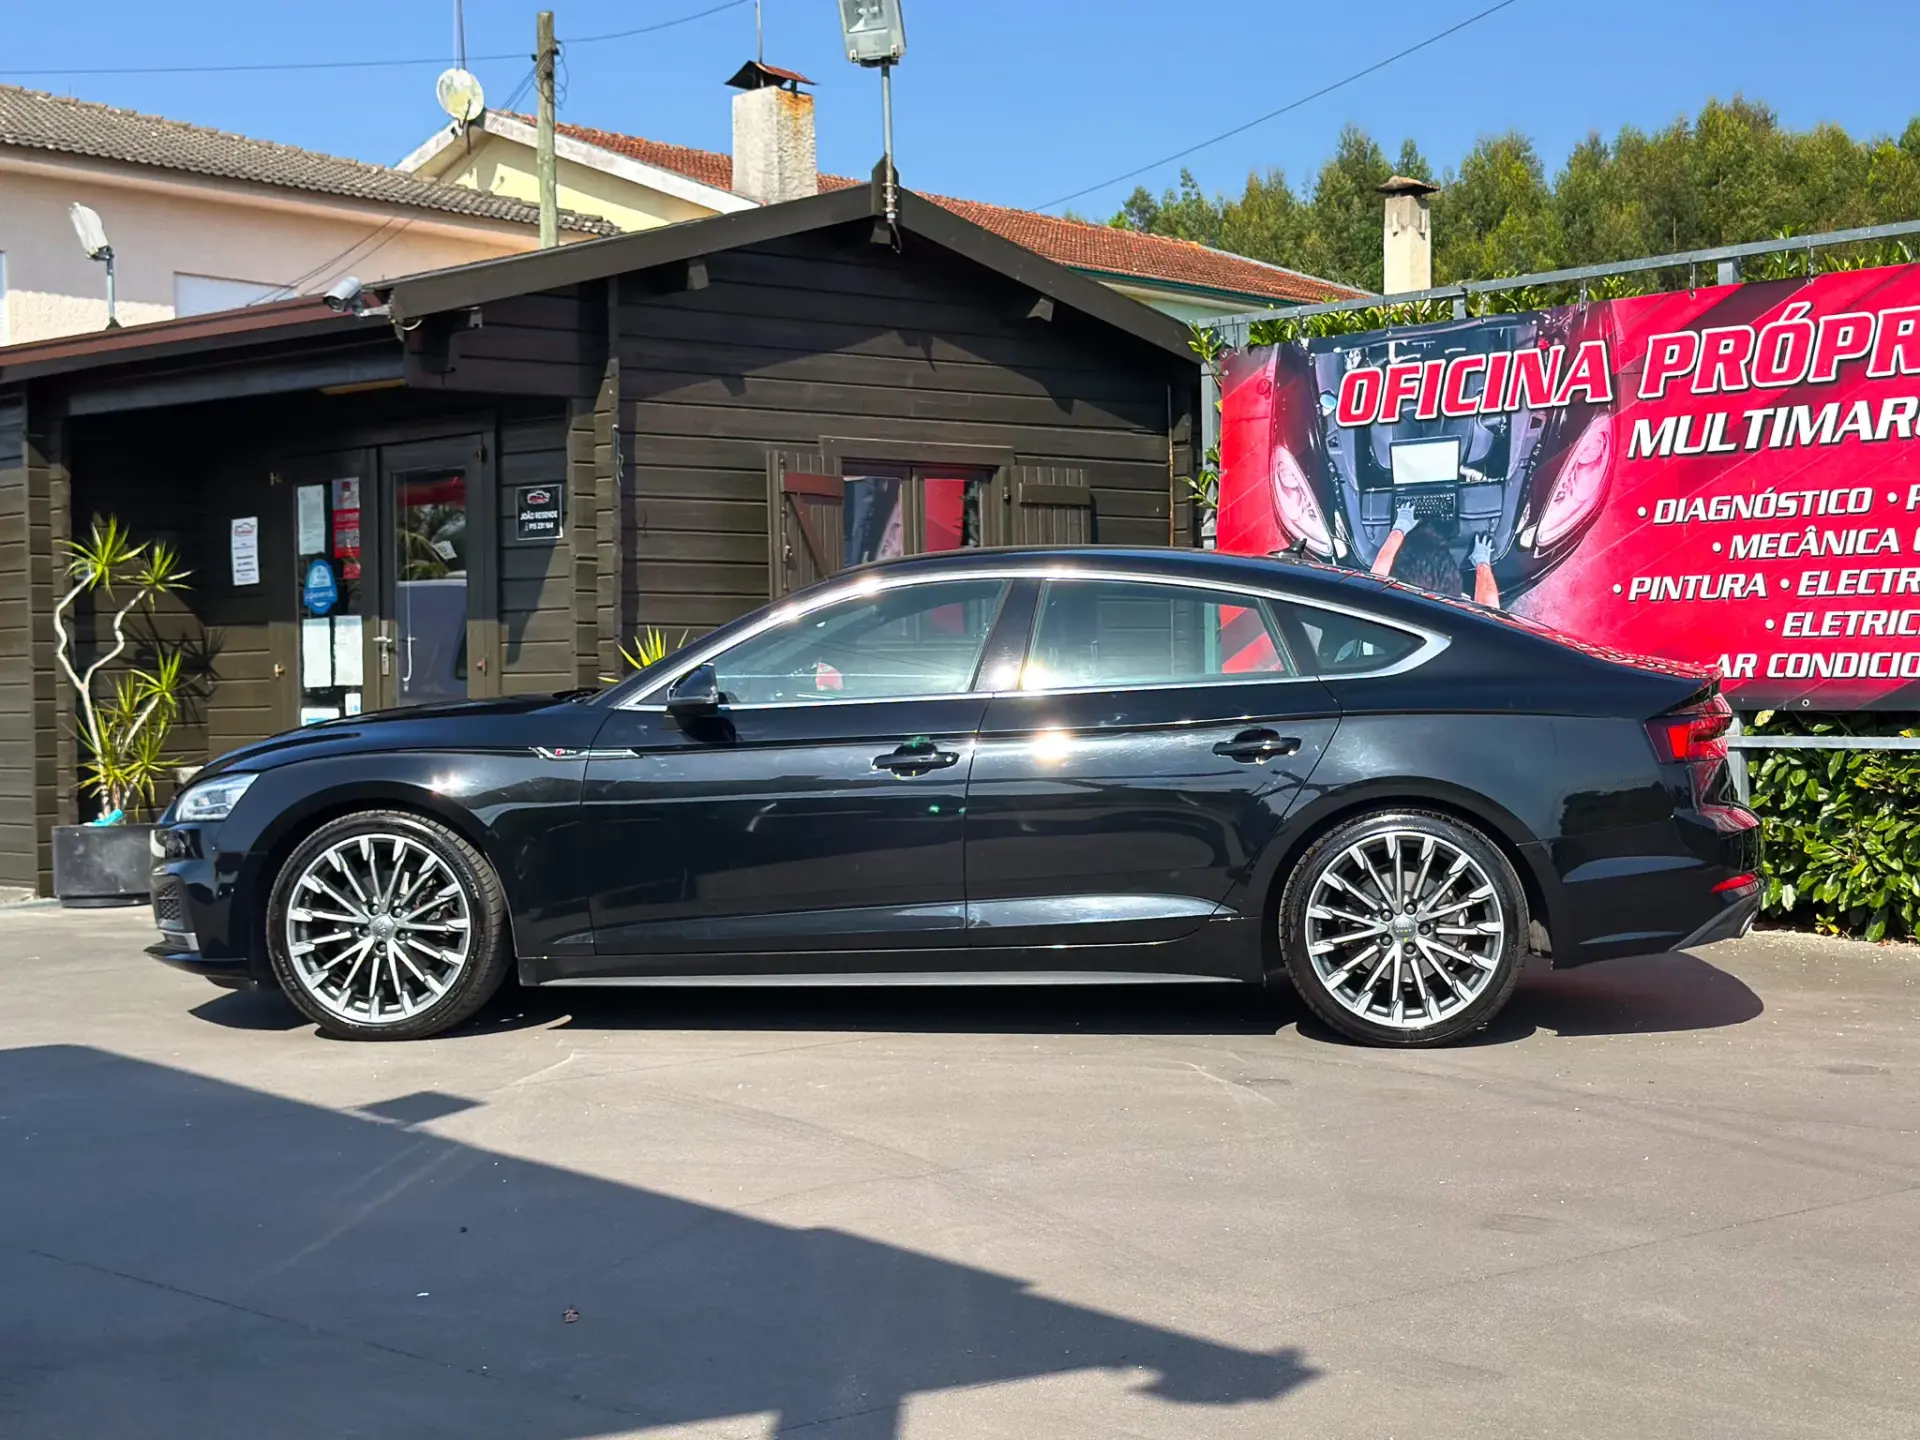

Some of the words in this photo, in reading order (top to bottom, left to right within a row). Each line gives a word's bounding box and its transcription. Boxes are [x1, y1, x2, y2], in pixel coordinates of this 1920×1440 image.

[1336, 340, 1613, 426] OFICINA
[1638, 301, 1920, 399] PRÓPR
[1627, 396, 1920, 459] MULTIMAR
[1654, 487, 1873, 525] DIAGNÓSTICO
[1729, 525, 1900, 560] MECÂNICA
[1629, 573, 1767, 601] PINTURA
[1797, 567, 1920, 597] ELECTR
[1716, 653, 1758, 678] AR
[1767, 652, 1920, 679] CONDICIO
